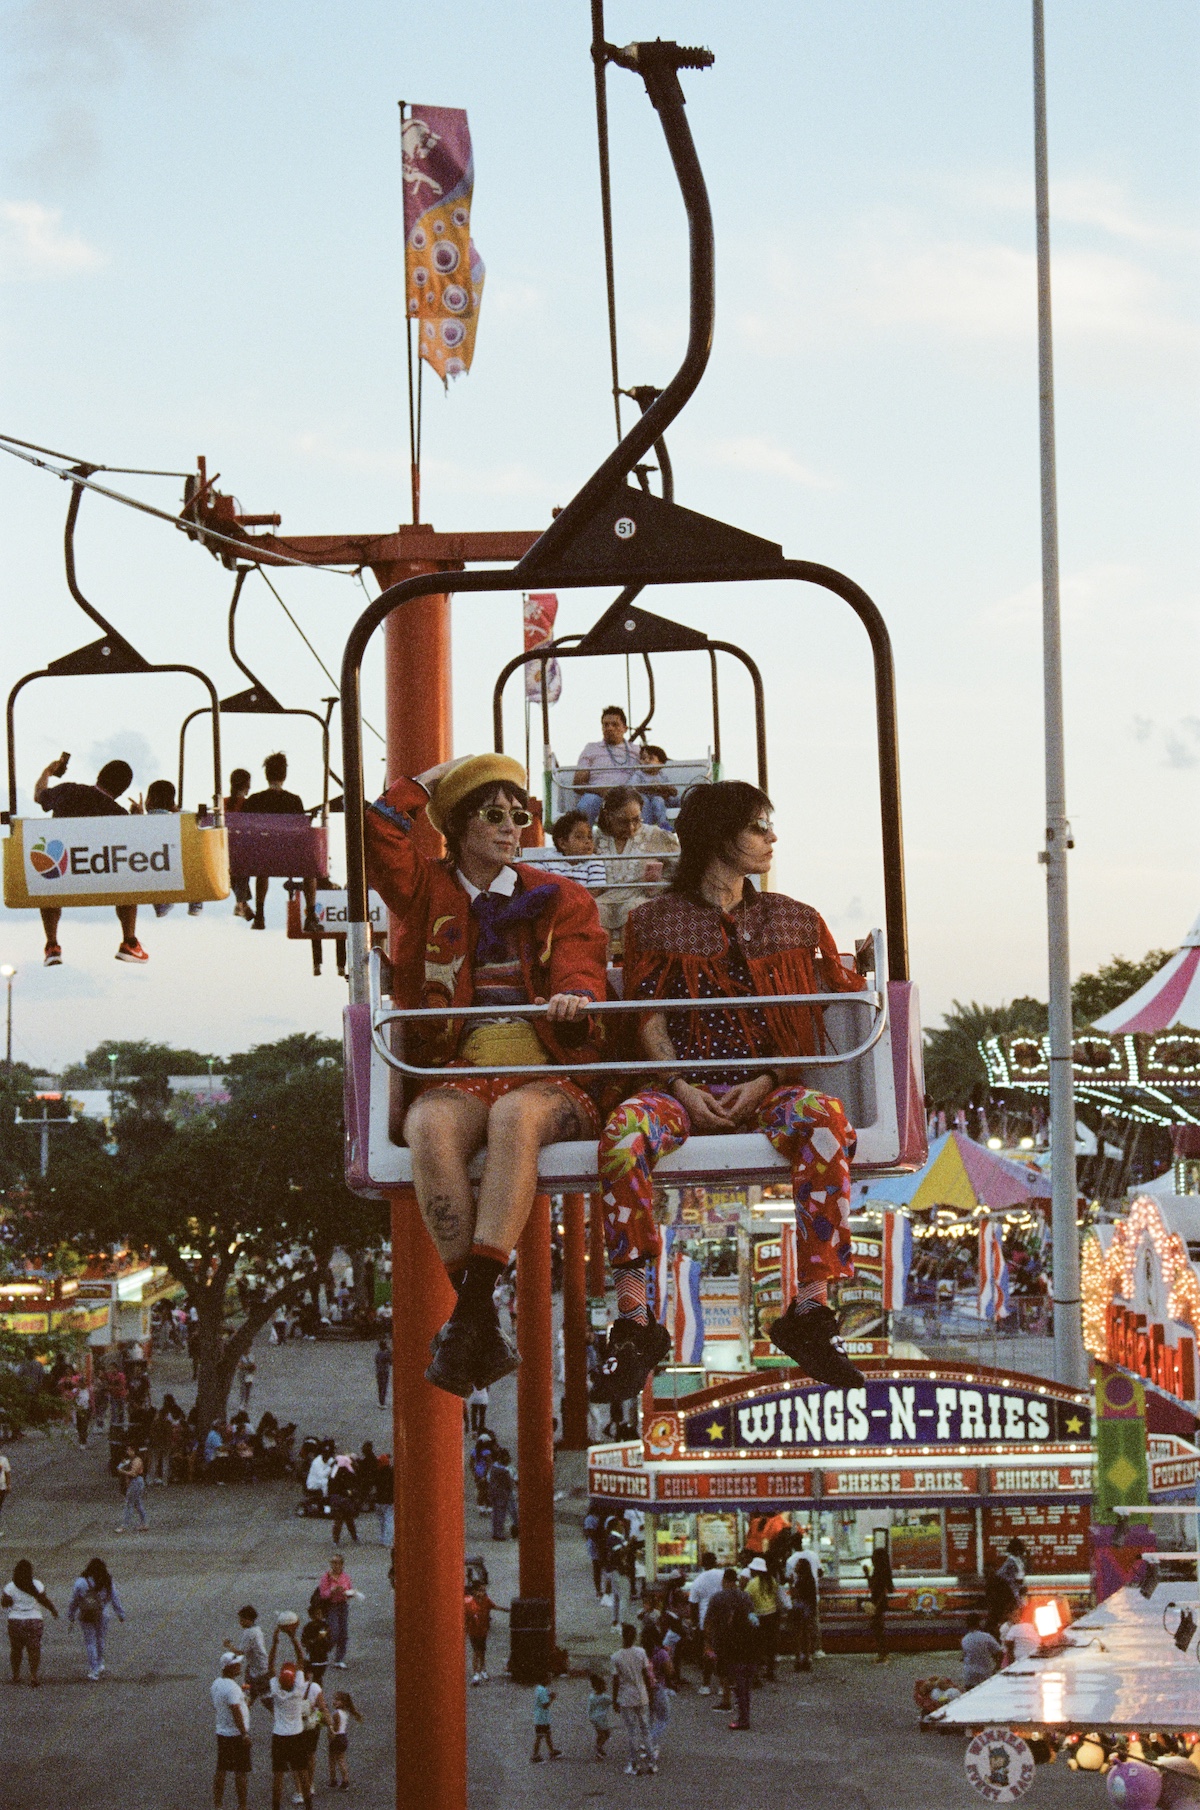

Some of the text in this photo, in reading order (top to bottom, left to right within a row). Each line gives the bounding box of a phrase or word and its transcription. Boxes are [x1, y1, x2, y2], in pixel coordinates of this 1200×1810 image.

[618, 522, 633, 534] 51
[70, 843, 171, 875] EdFed
[326, 906, 380, 922] Edd
[738, 1386, 1050, 1443] WINGS-N-FRIES
[593, 1472, 647, 1496] POUTINE
[664, 1475, 805, 1497] CHILI CHEESE FRIES
[838, 1472, 963, 1493] CHEESE FRIES
[996, 1470, 1059, 1490] CHICKEN
